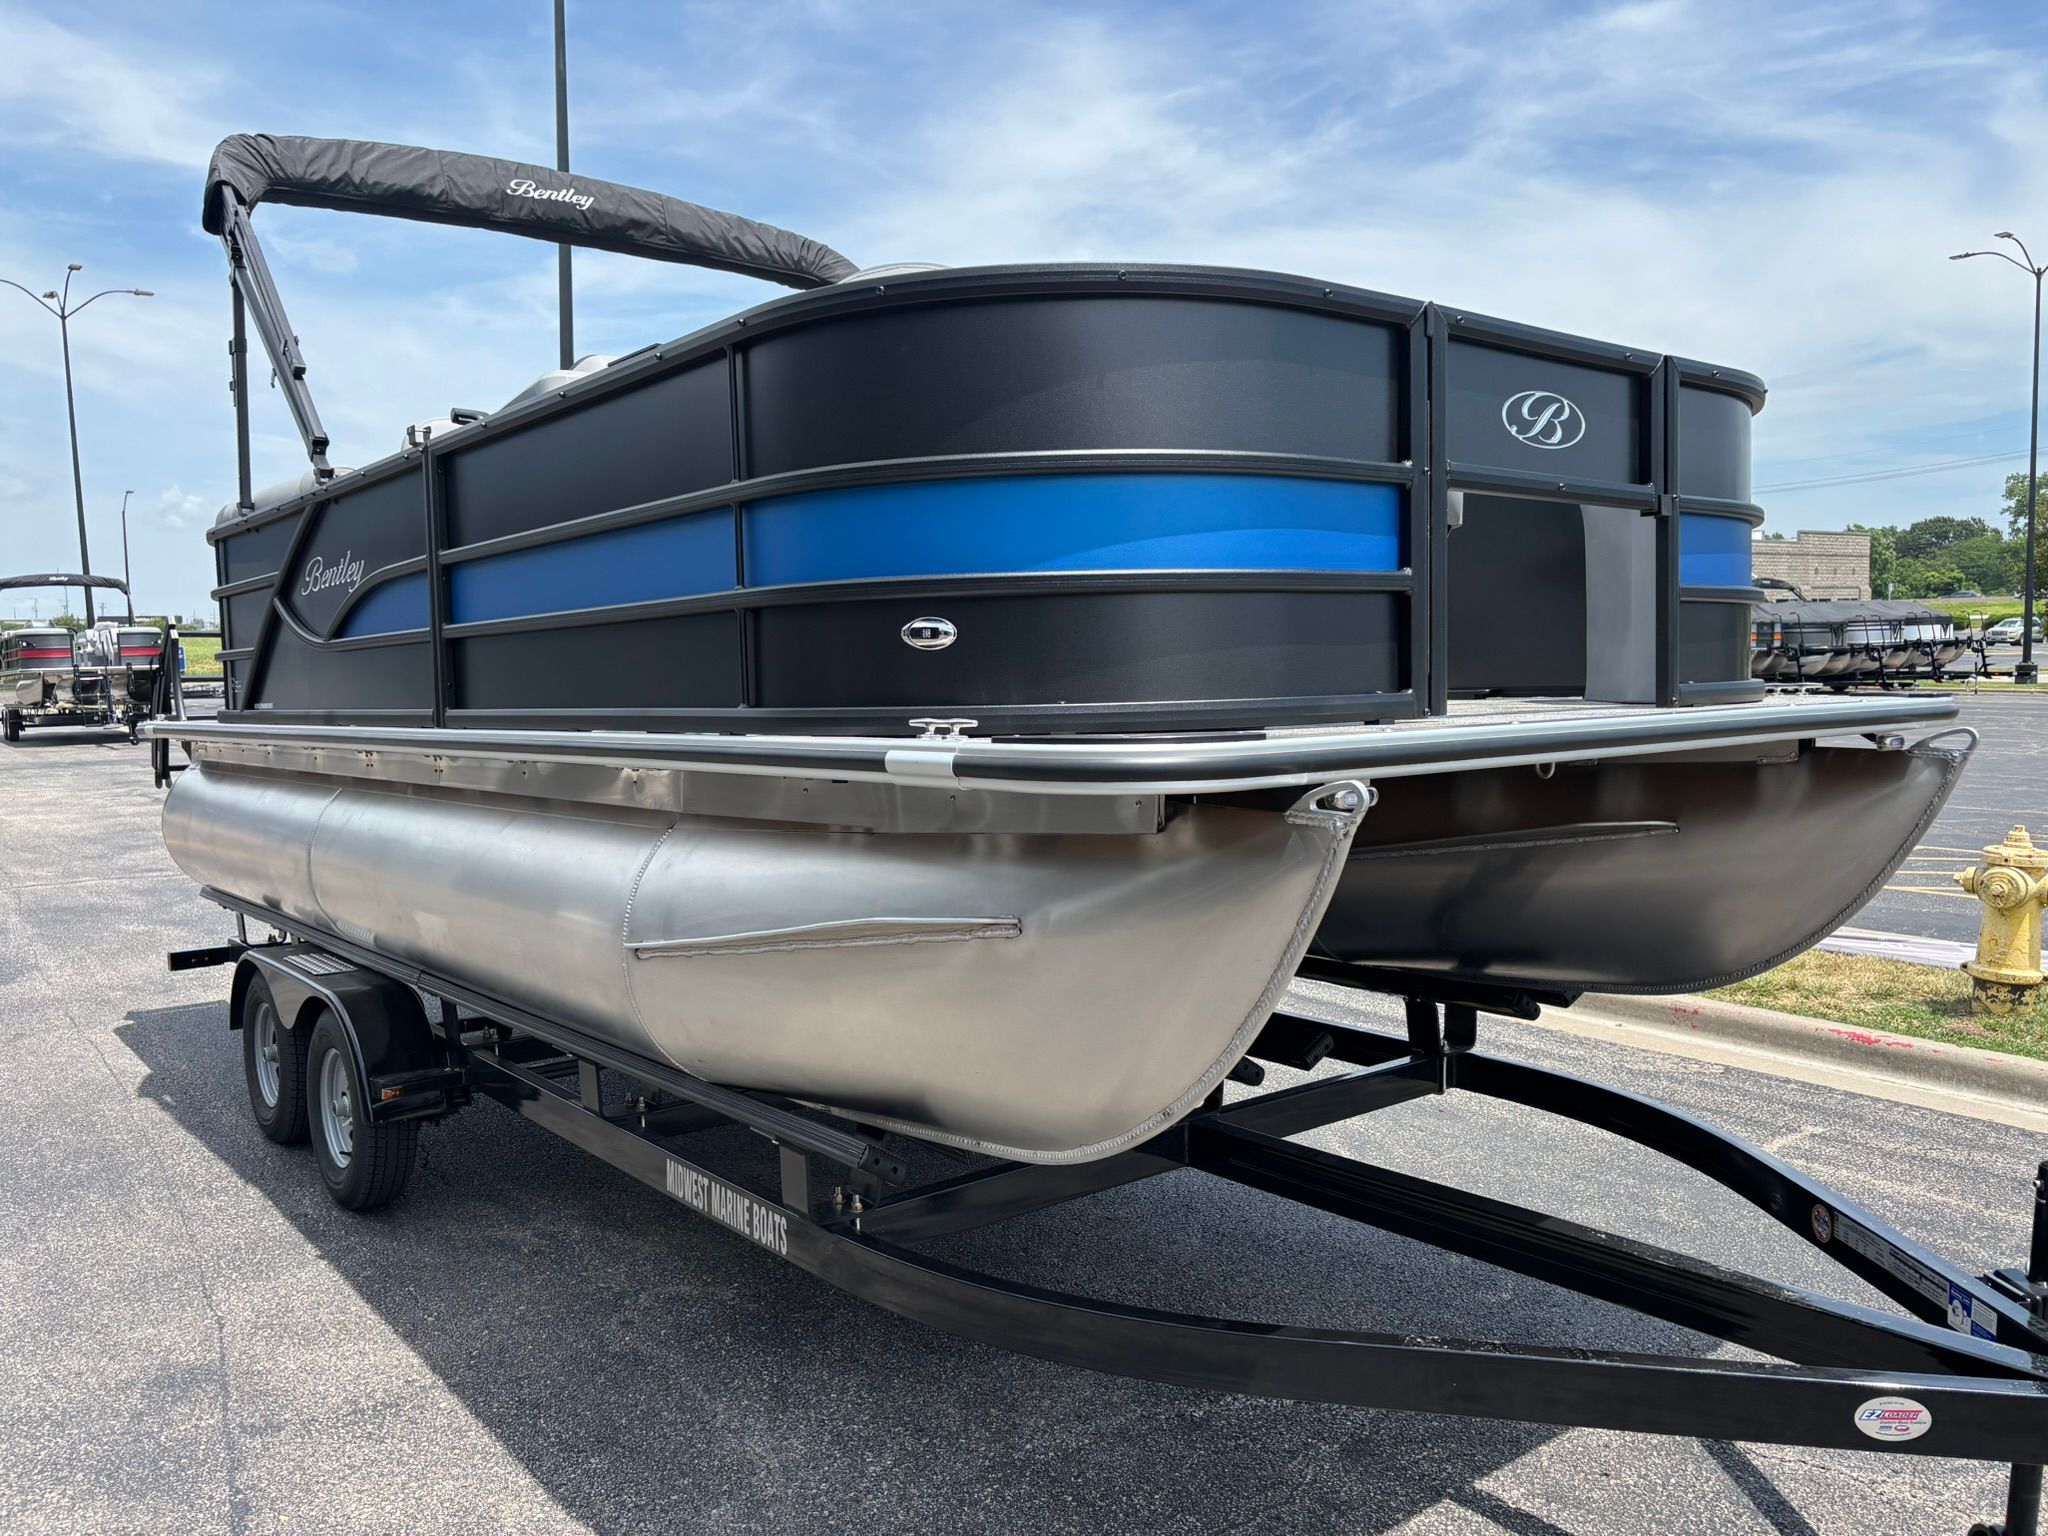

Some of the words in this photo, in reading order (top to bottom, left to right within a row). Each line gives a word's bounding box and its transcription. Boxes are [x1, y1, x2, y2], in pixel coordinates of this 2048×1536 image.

[506, 179, 595, 210] Bentley
[301, 550, 365, 596] Bentley
[666, 1158, 709, 1212] MIDWEST
[711, 1181, 750, 1236] MARINE
[753, 1202, 788, 1256] BOATS
[1861, 1410, 1881, 1420] EZ
